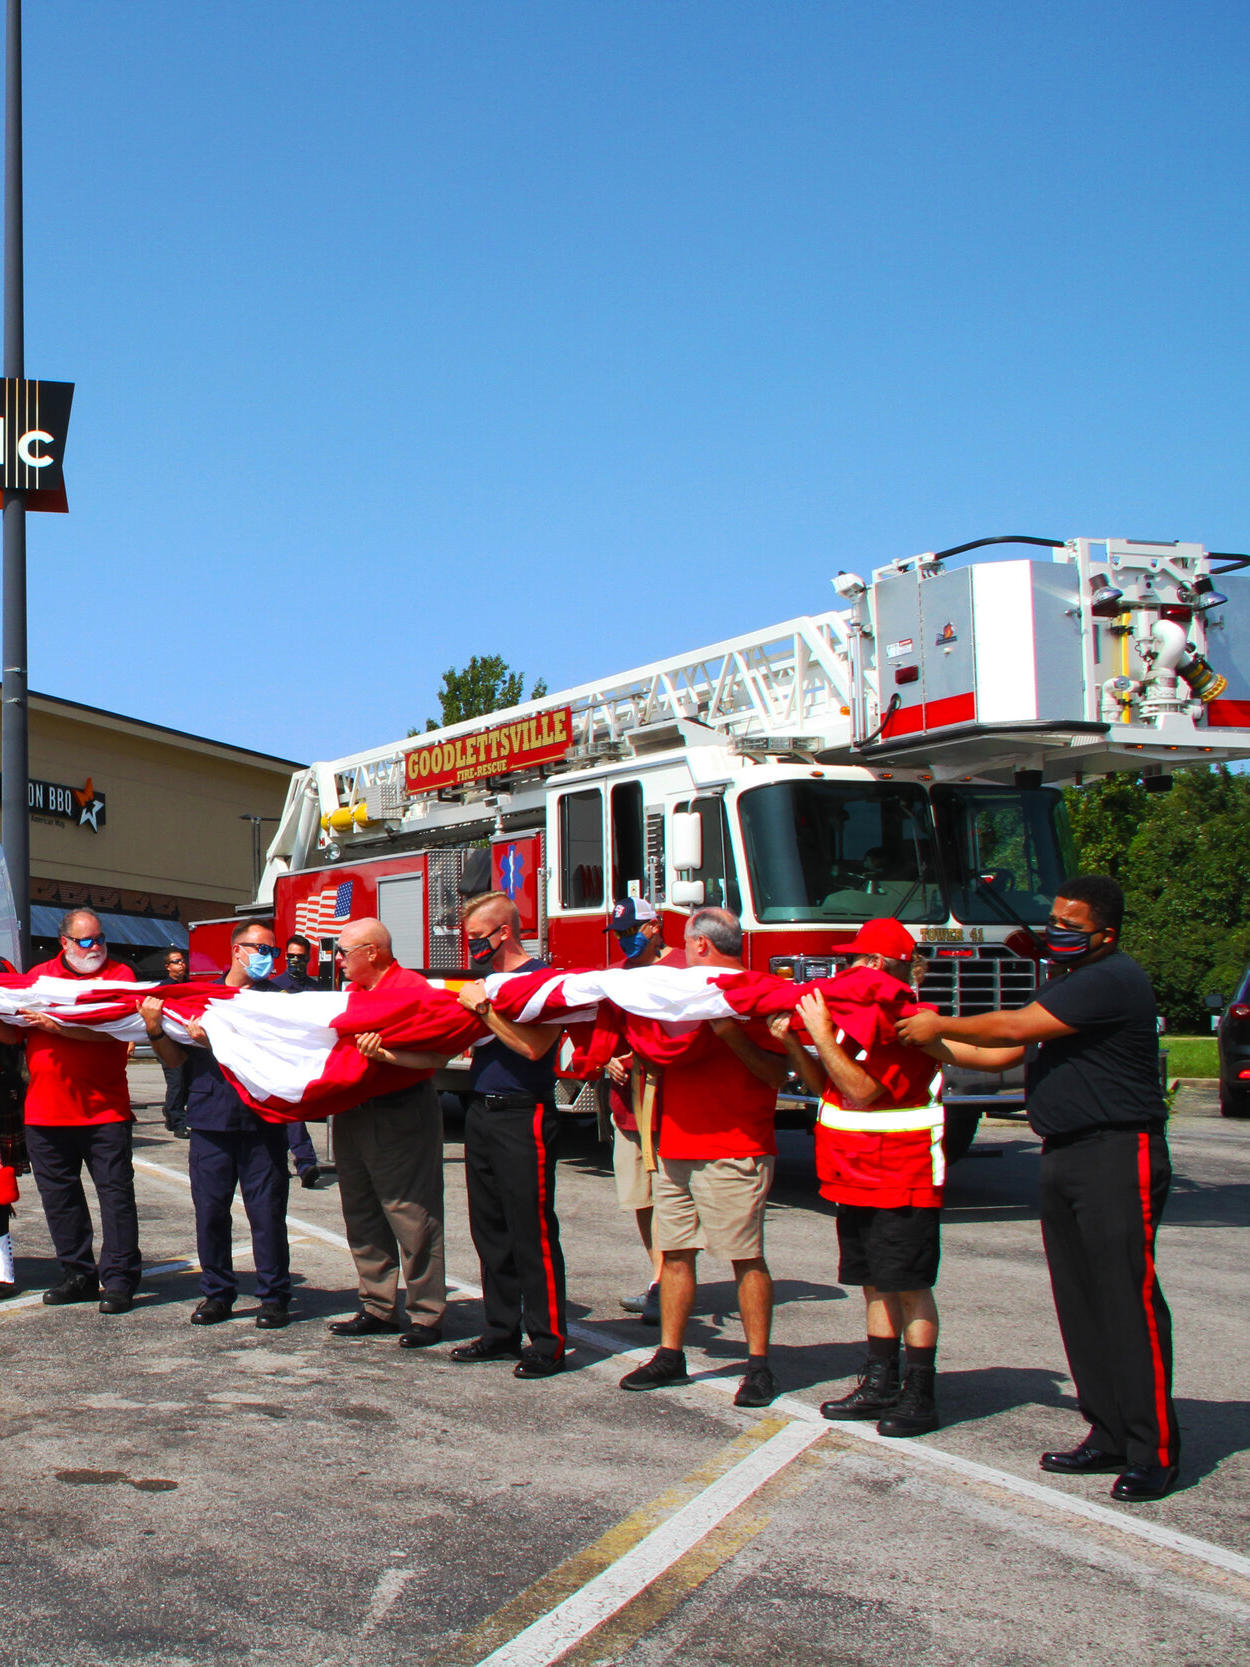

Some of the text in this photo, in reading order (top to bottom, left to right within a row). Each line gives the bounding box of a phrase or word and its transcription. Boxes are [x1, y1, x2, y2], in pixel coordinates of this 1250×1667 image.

[407, 710, 568, 780] GOODLETTSVILLE
[456, 759, 508, 783] FIRE-RESCUE
[49, 786, 72, 817] BBQ
[920, 927, 984, 942] TOWER 41
